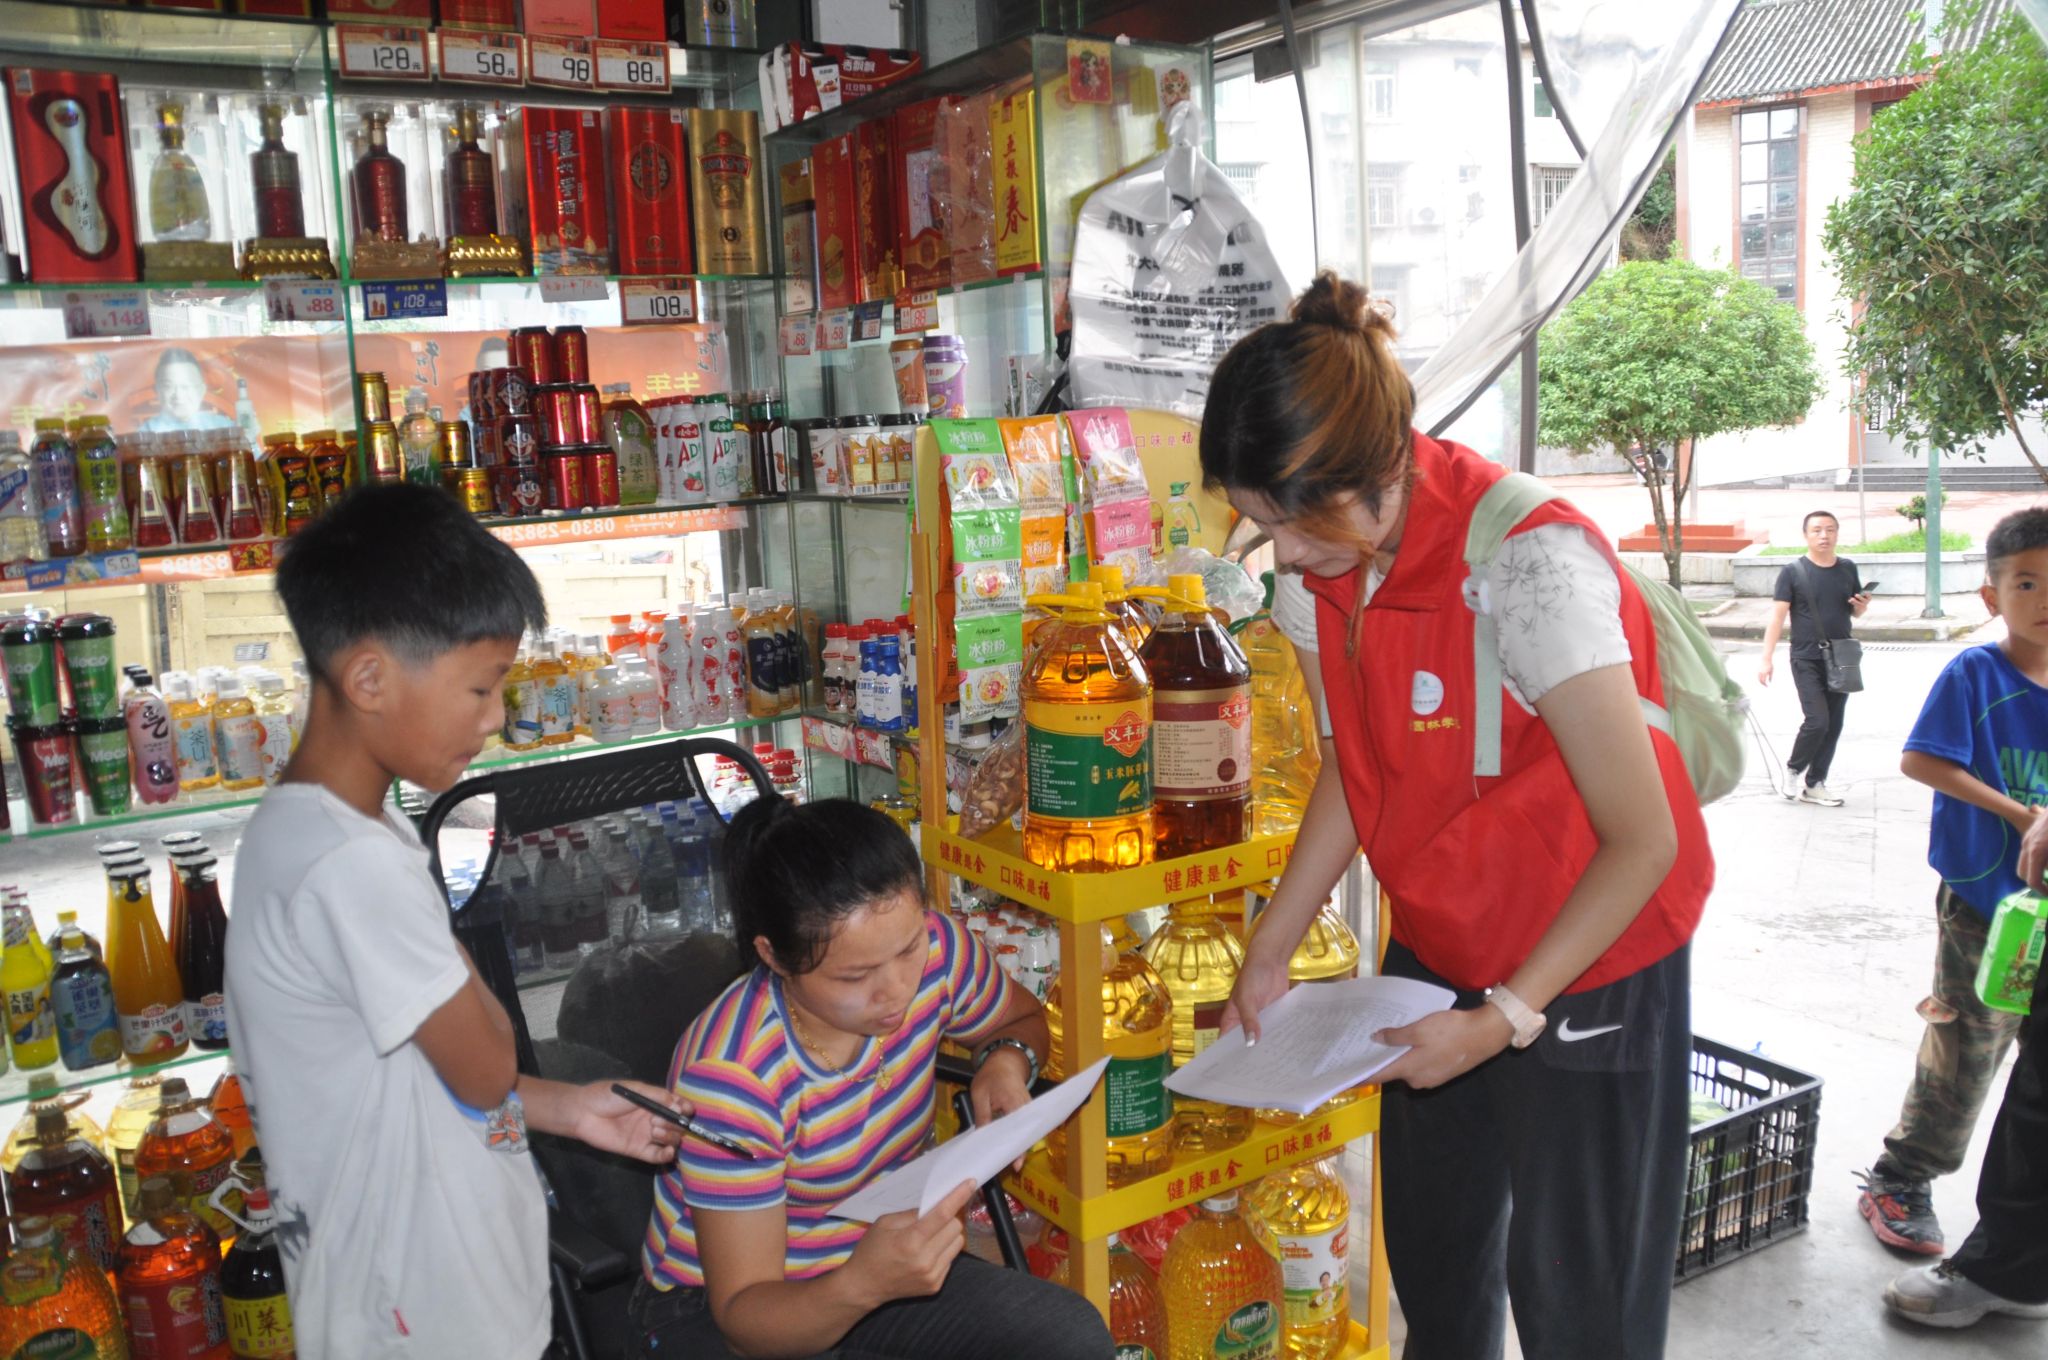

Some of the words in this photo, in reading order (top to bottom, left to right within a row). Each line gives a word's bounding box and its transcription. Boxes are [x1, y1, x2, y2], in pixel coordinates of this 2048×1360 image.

[940, 840, 986, 875] 健康是金
[1163, 856, 1244, 895] 健康是金
[1001, 866, 1051, 901] 口味是福
[1265, 1123, 1334, 1166] 口味是福
[1166, 1158, 1244, 1203] 健康是金
